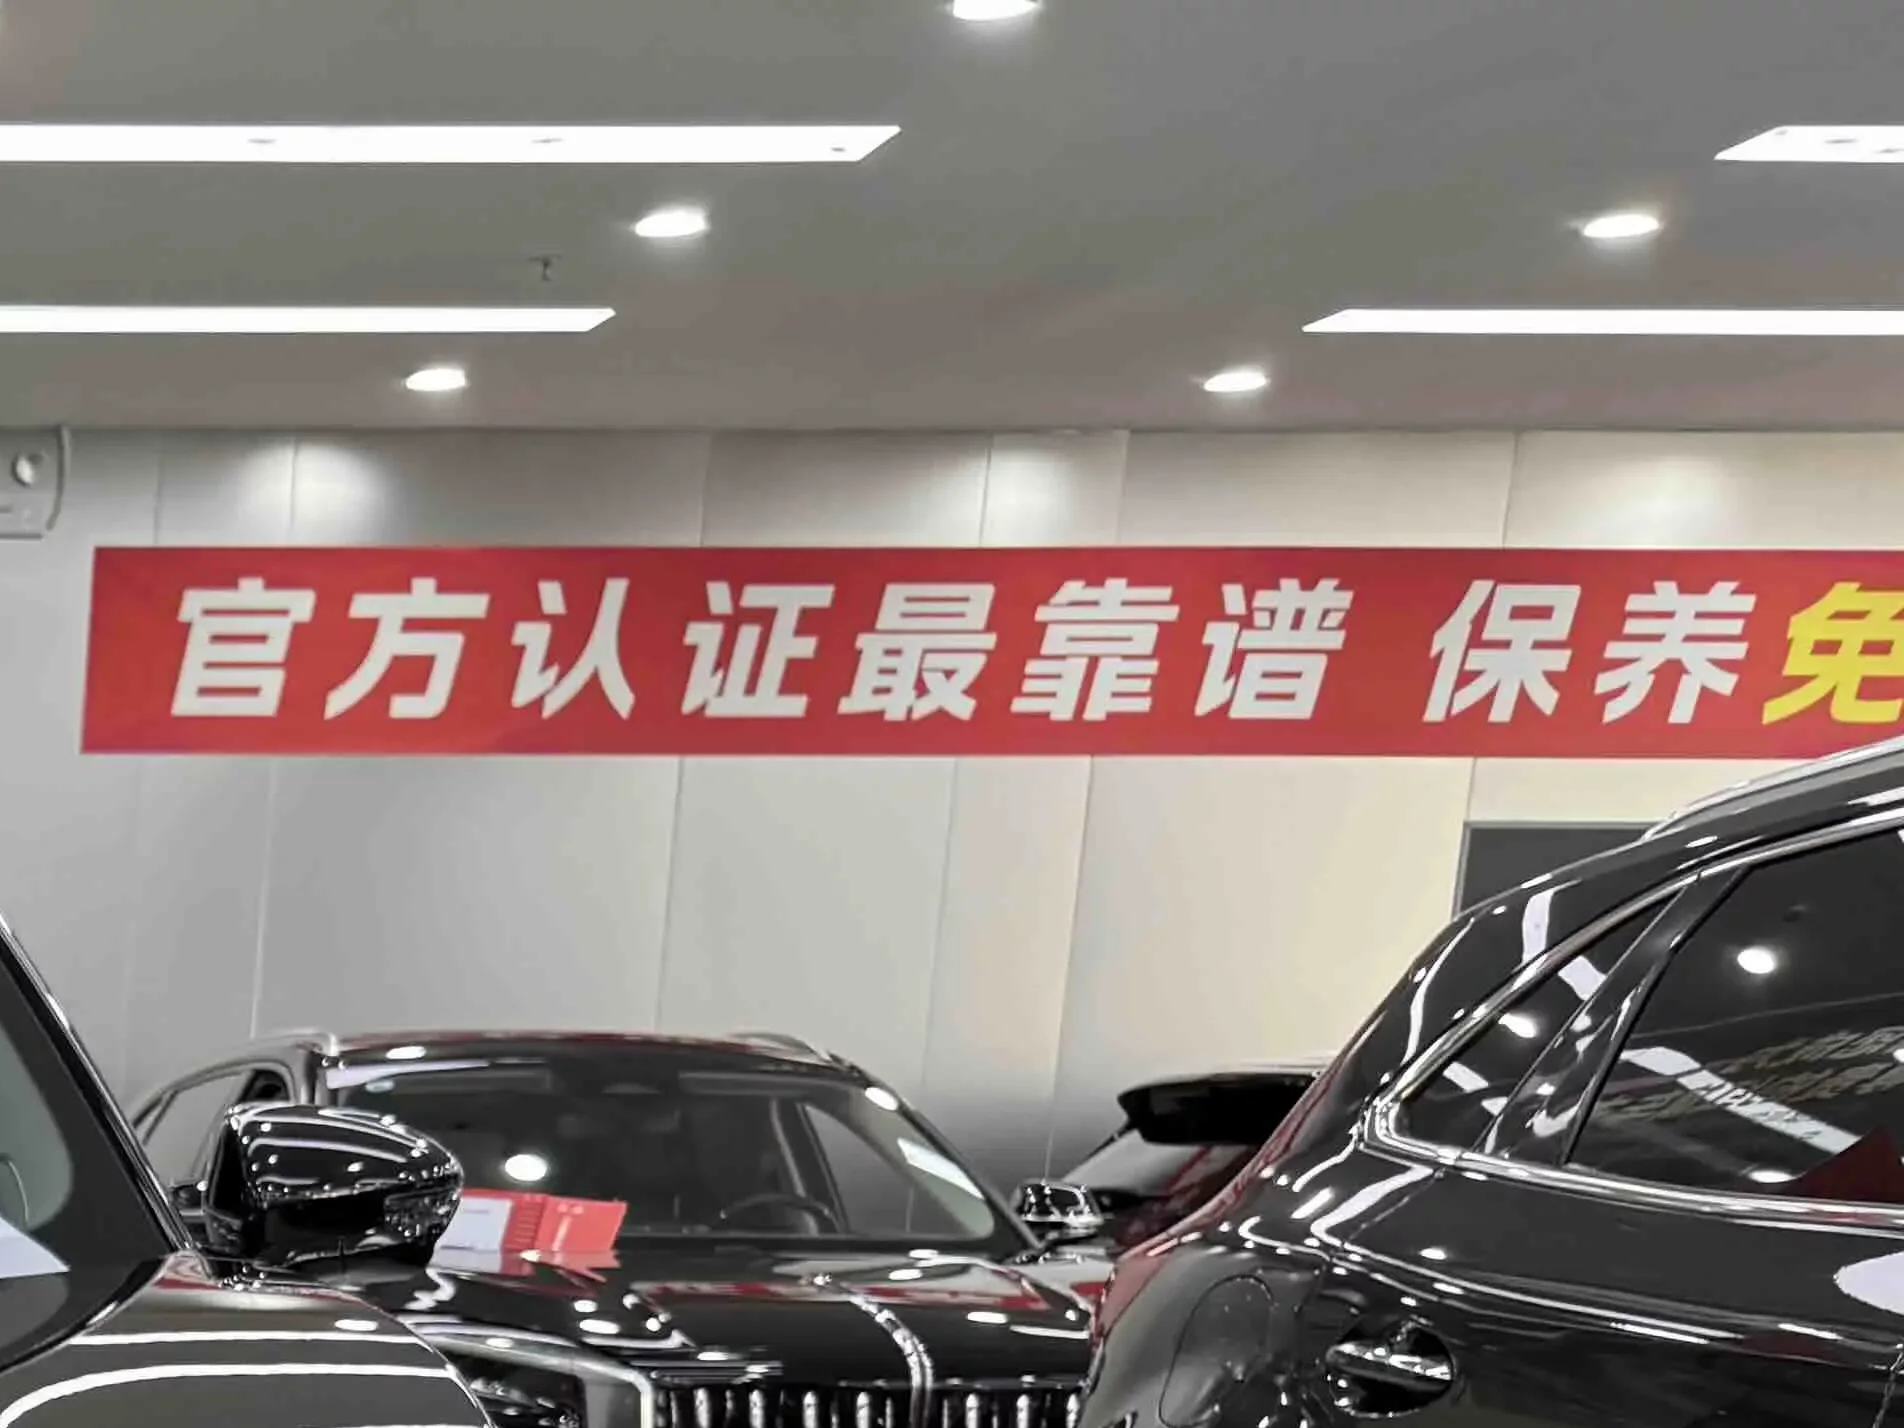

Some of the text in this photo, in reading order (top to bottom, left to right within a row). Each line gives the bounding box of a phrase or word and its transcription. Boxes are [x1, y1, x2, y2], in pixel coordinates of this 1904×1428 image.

[170, 577, 1352, 722] 官方认证最靠谱
